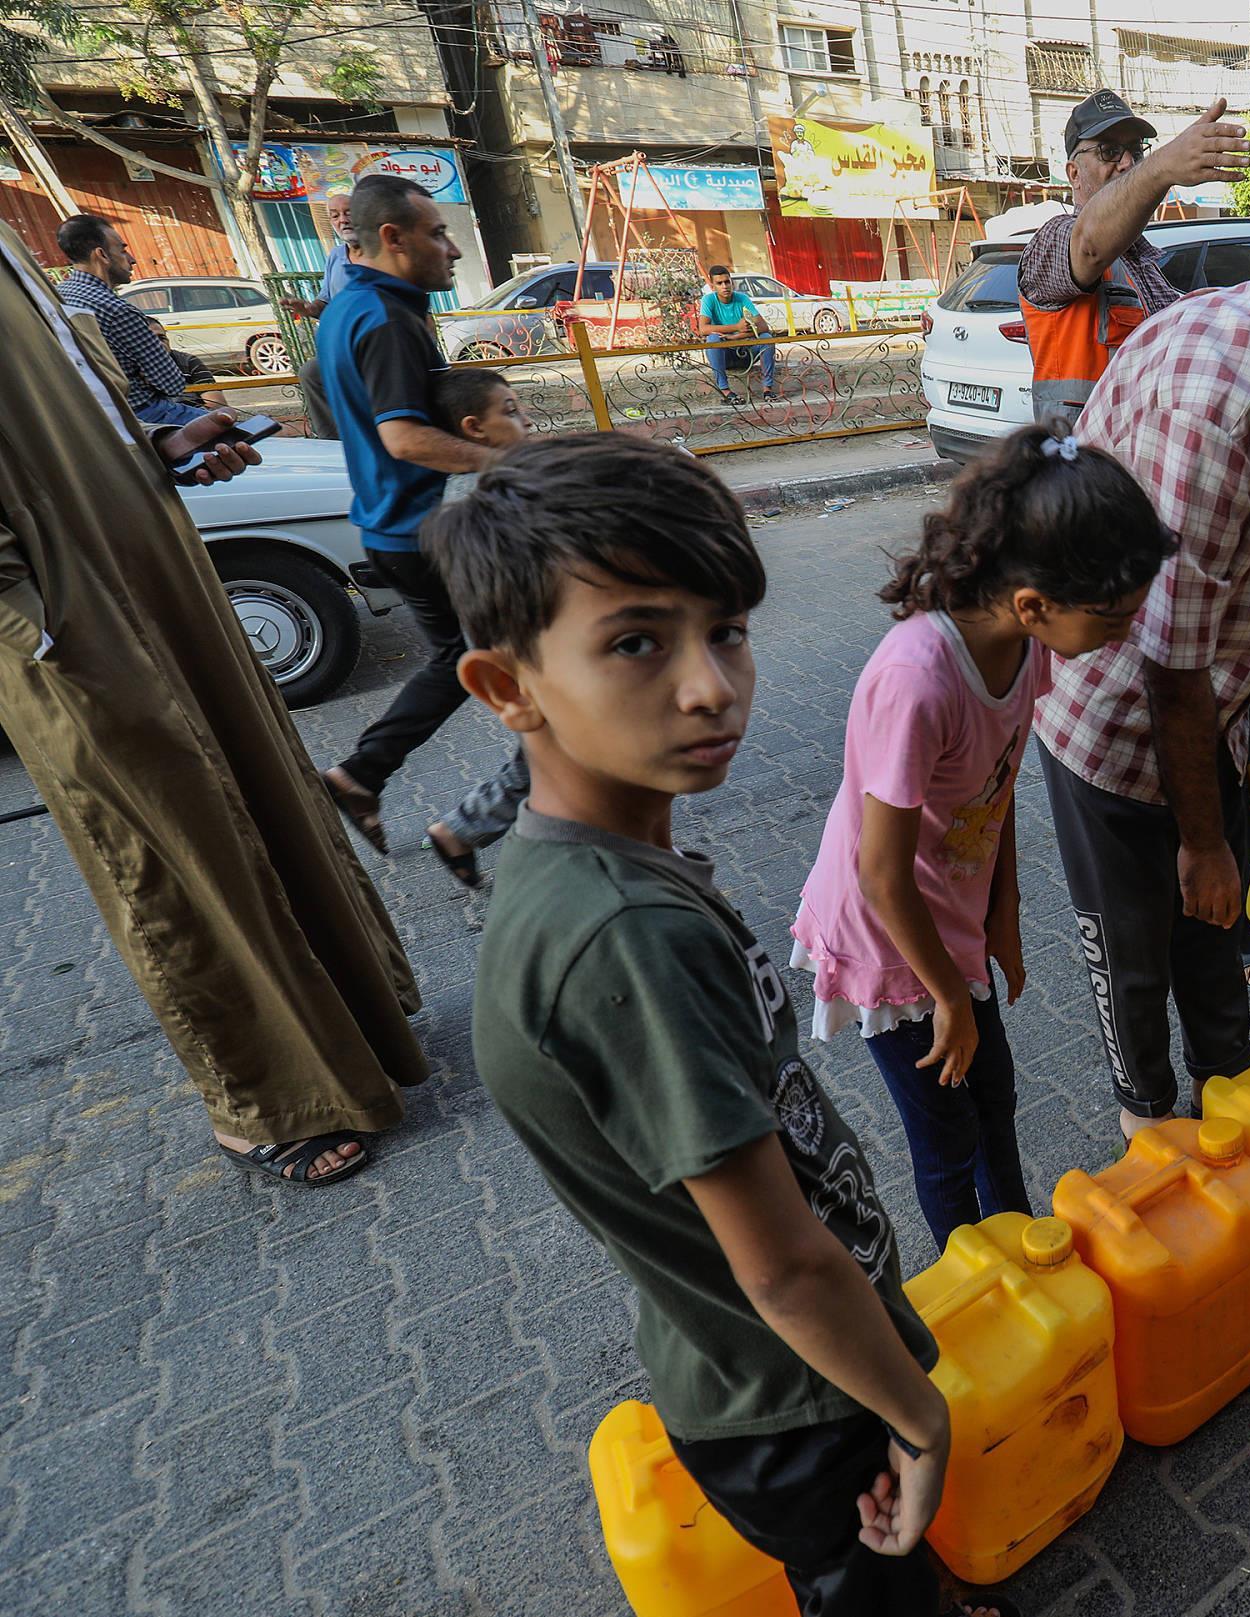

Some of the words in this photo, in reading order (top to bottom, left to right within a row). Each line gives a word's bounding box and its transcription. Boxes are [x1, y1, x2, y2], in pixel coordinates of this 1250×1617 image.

[381, 160, 417, 174] عواد
[420, 159, 442, 176] أبو
[832, 143, 884, 177] القدس
[889, 145, 926, 180] مخبز
[704, 173, 756, 191] صيدلية
